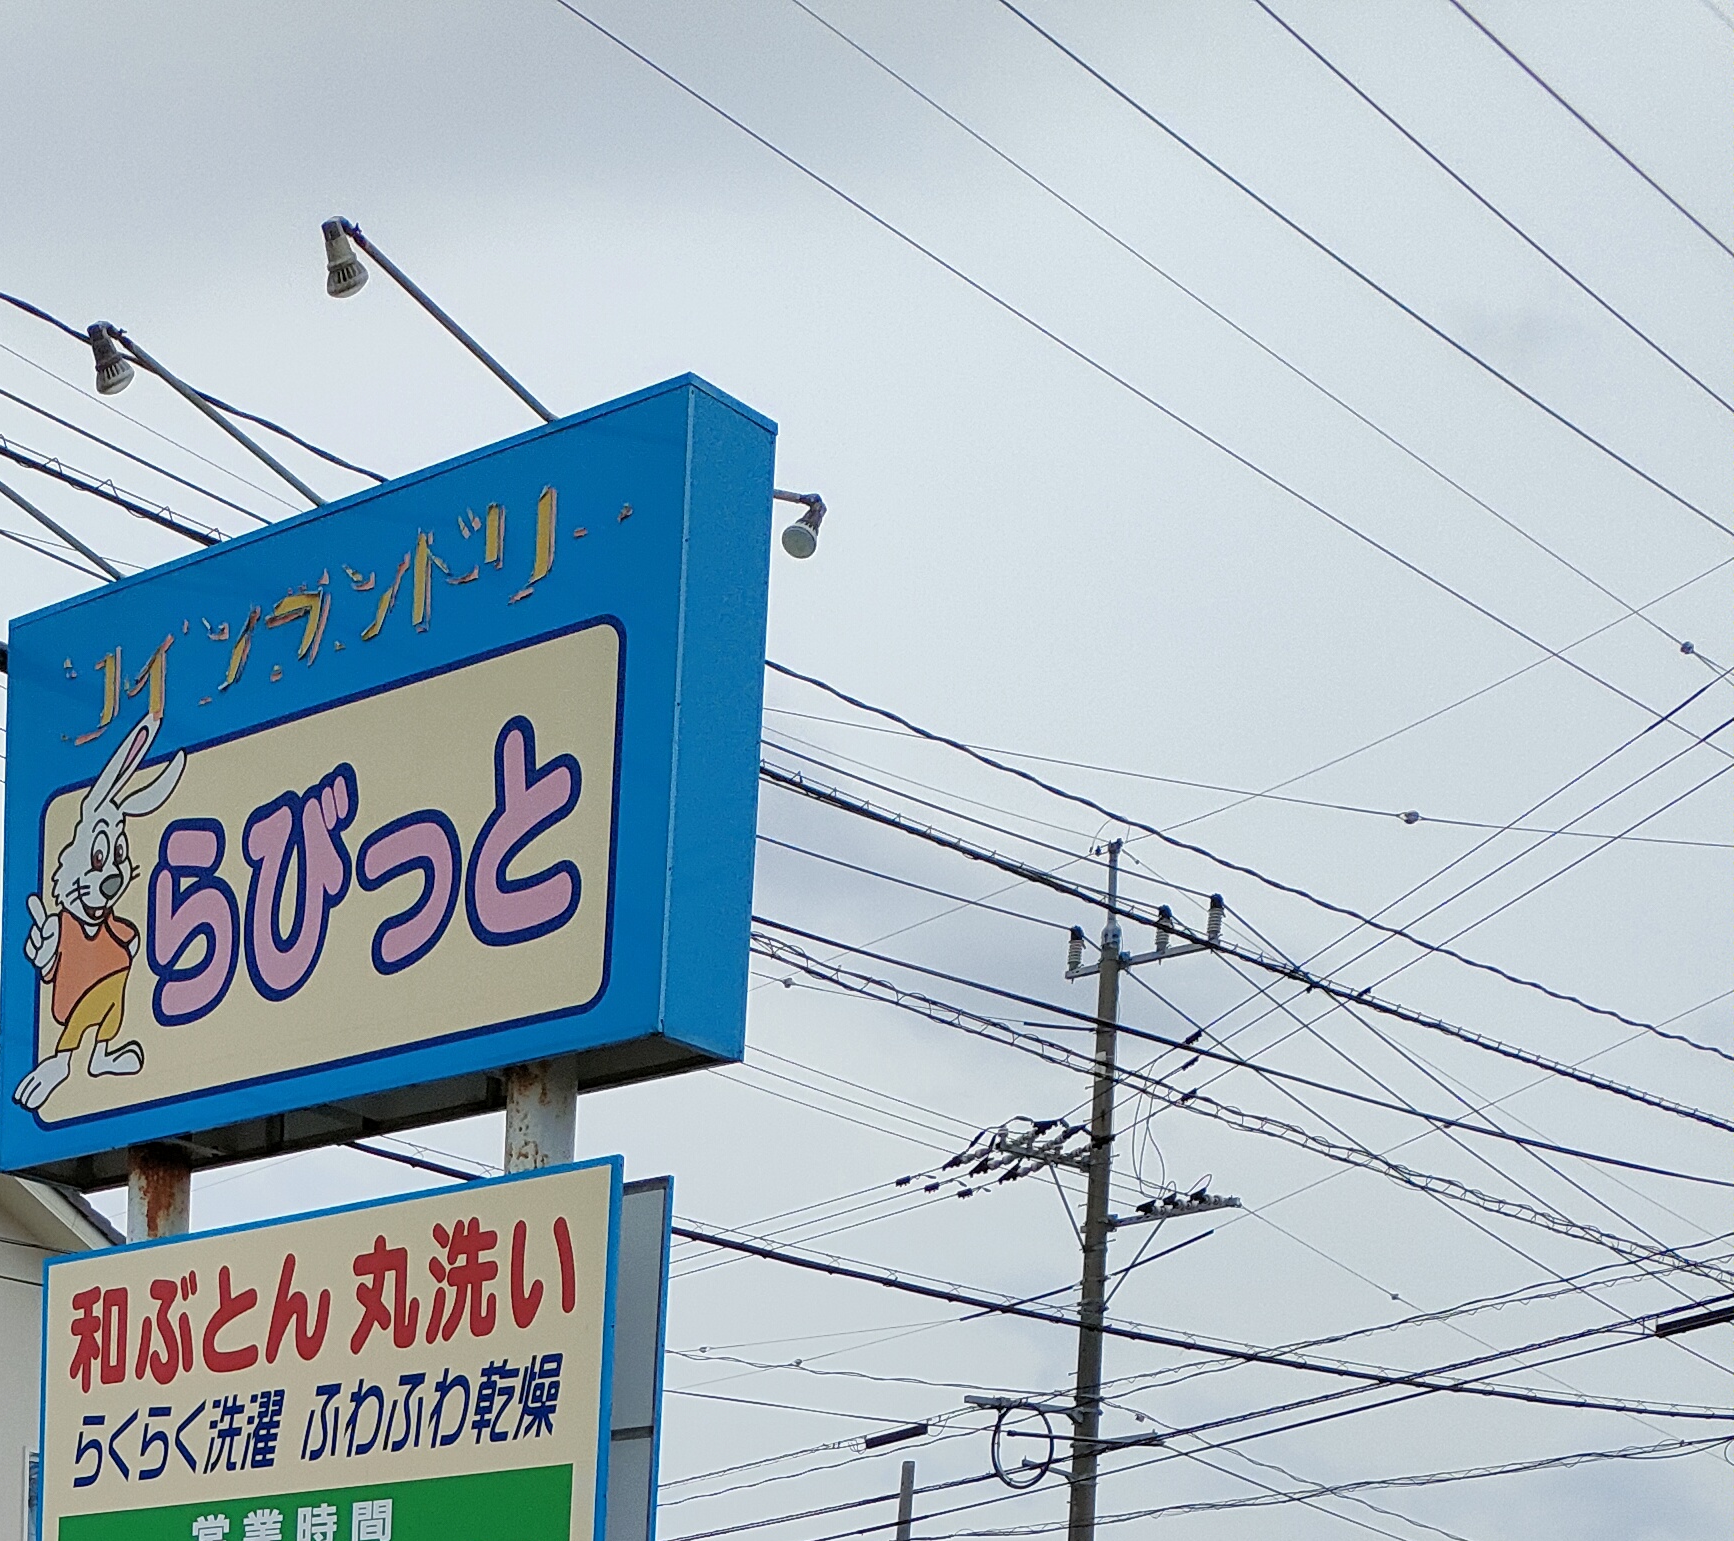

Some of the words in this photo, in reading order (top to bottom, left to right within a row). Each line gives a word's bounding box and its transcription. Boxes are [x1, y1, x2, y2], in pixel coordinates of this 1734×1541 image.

[70, 1252, 330, 1393] 和ぶとん
[350, 1217, 576, 1355] 丸洗い
[73, 1388, 285, 1488] らくらく洗濯
[300, 1352, 564, 1461] ふわふわ乾燥
